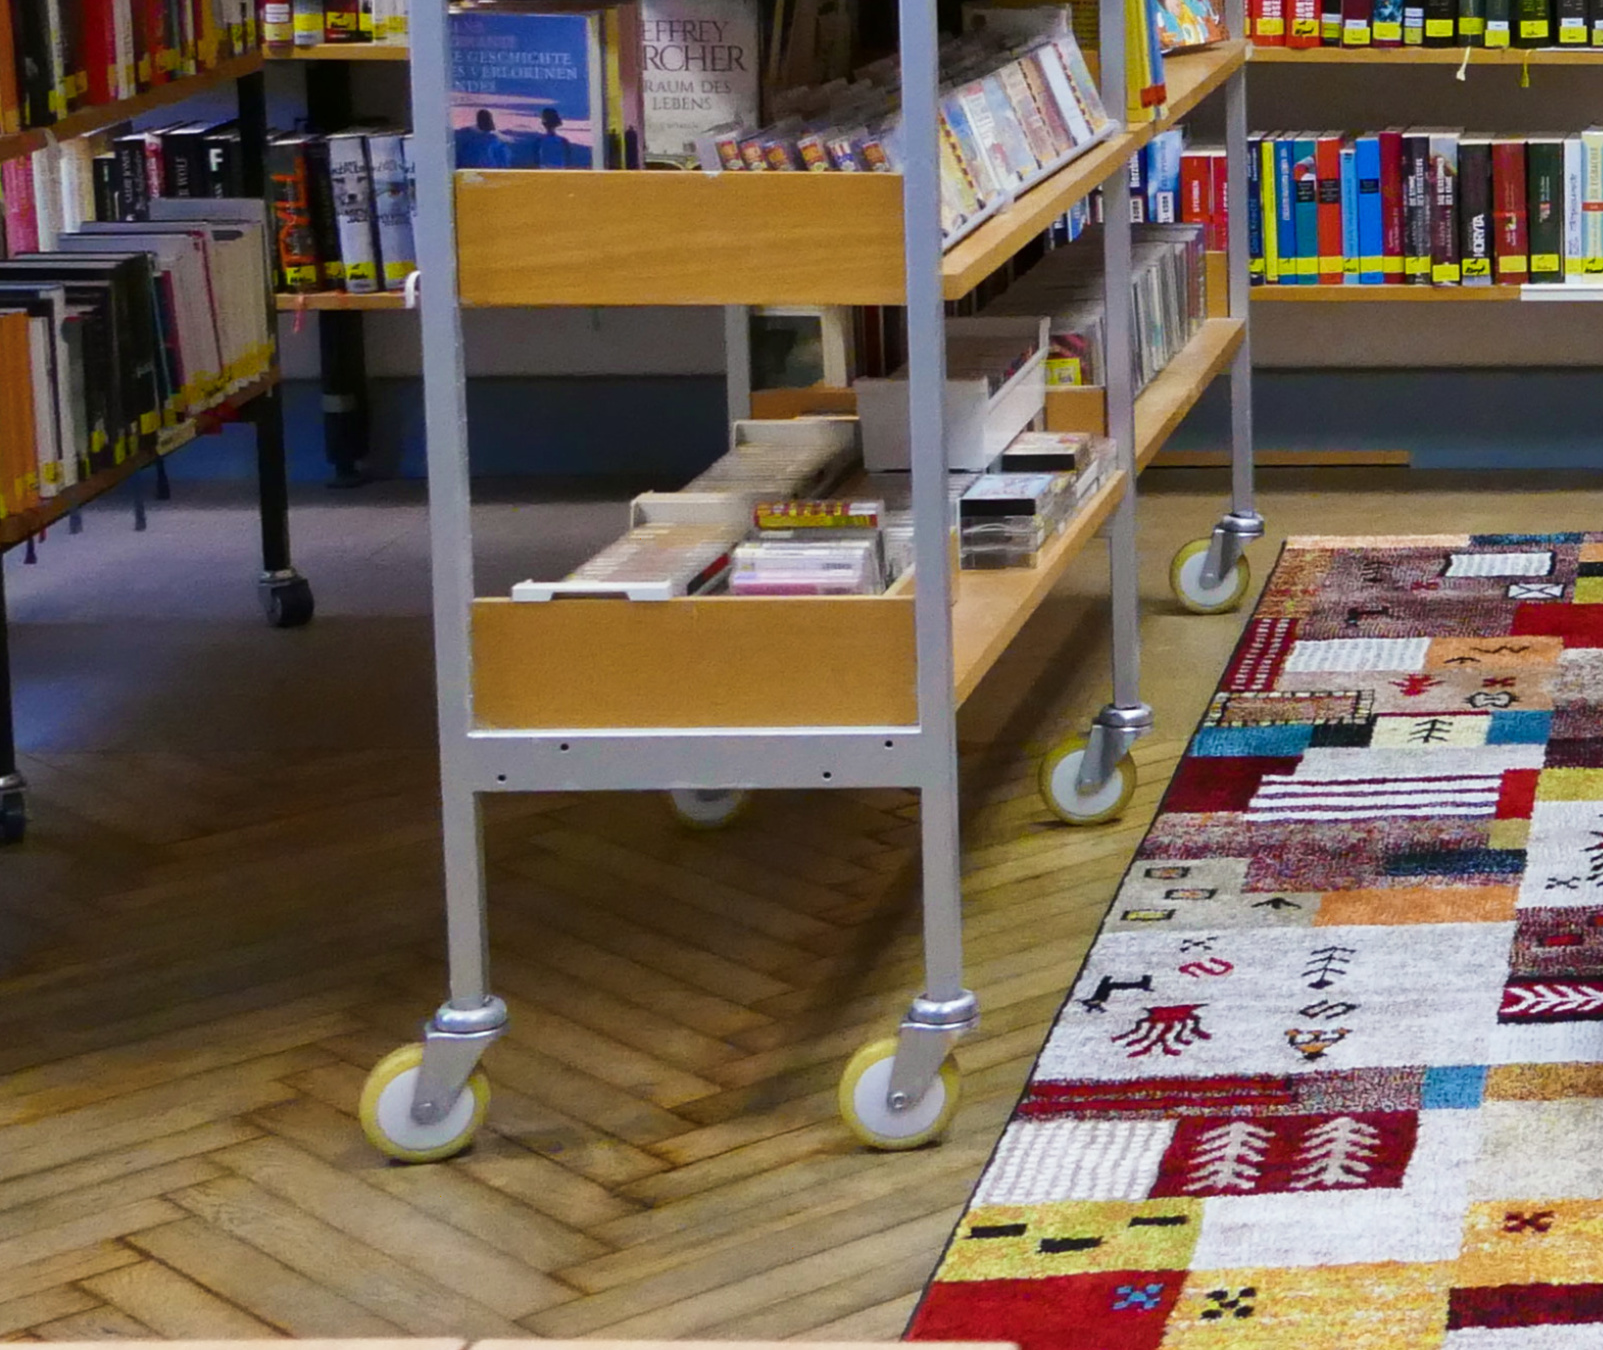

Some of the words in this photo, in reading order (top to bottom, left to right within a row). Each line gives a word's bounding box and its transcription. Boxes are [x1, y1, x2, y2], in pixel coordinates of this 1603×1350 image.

[643, 20, 729, 42] EFFREY
[644, 45, 747, 72] RCHER
[652, 97, 712, 110] LEBENS
